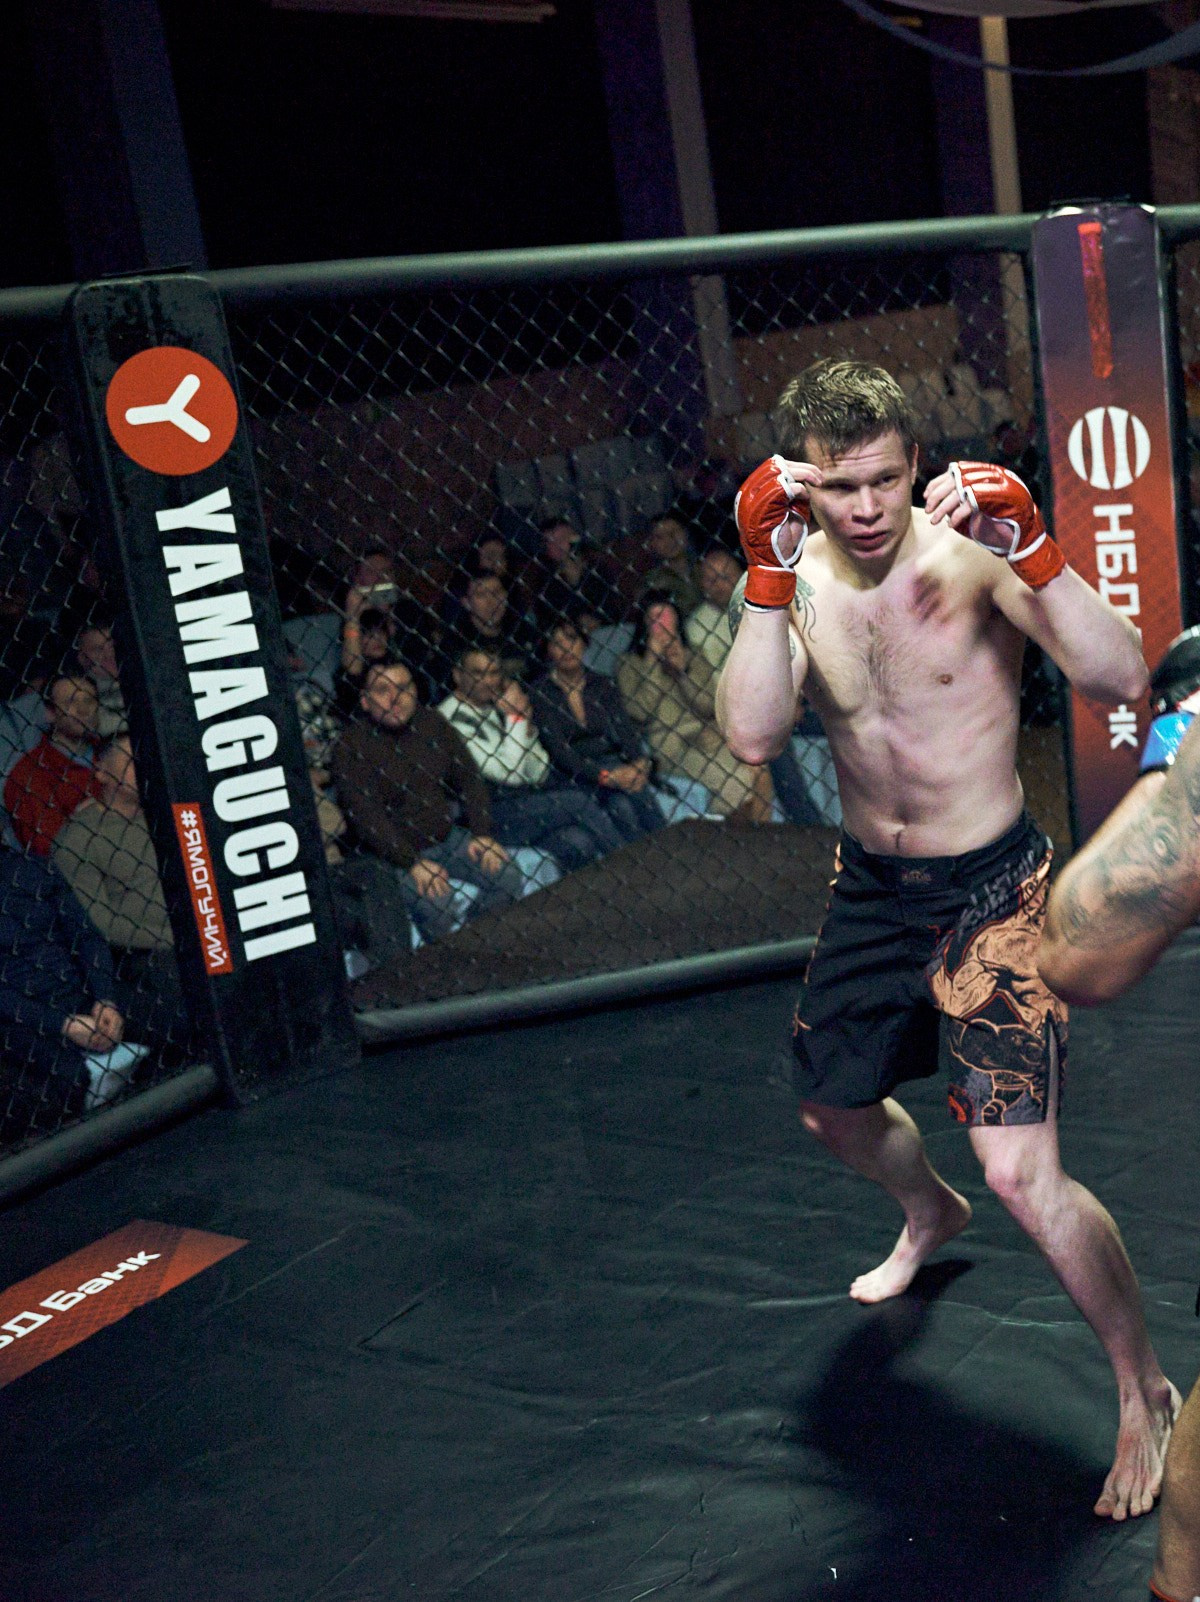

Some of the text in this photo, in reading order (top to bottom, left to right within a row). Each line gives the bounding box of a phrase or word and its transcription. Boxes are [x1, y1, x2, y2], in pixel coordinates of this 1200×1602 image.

[1092, 503, 1141, 617] НБД
[154, 486, 318, 963] YAMAGUCHI
[180, 809, 229, 968] #ЯМОГУЧИЙ
[0, 1250, 162, 1350] Д Банк
